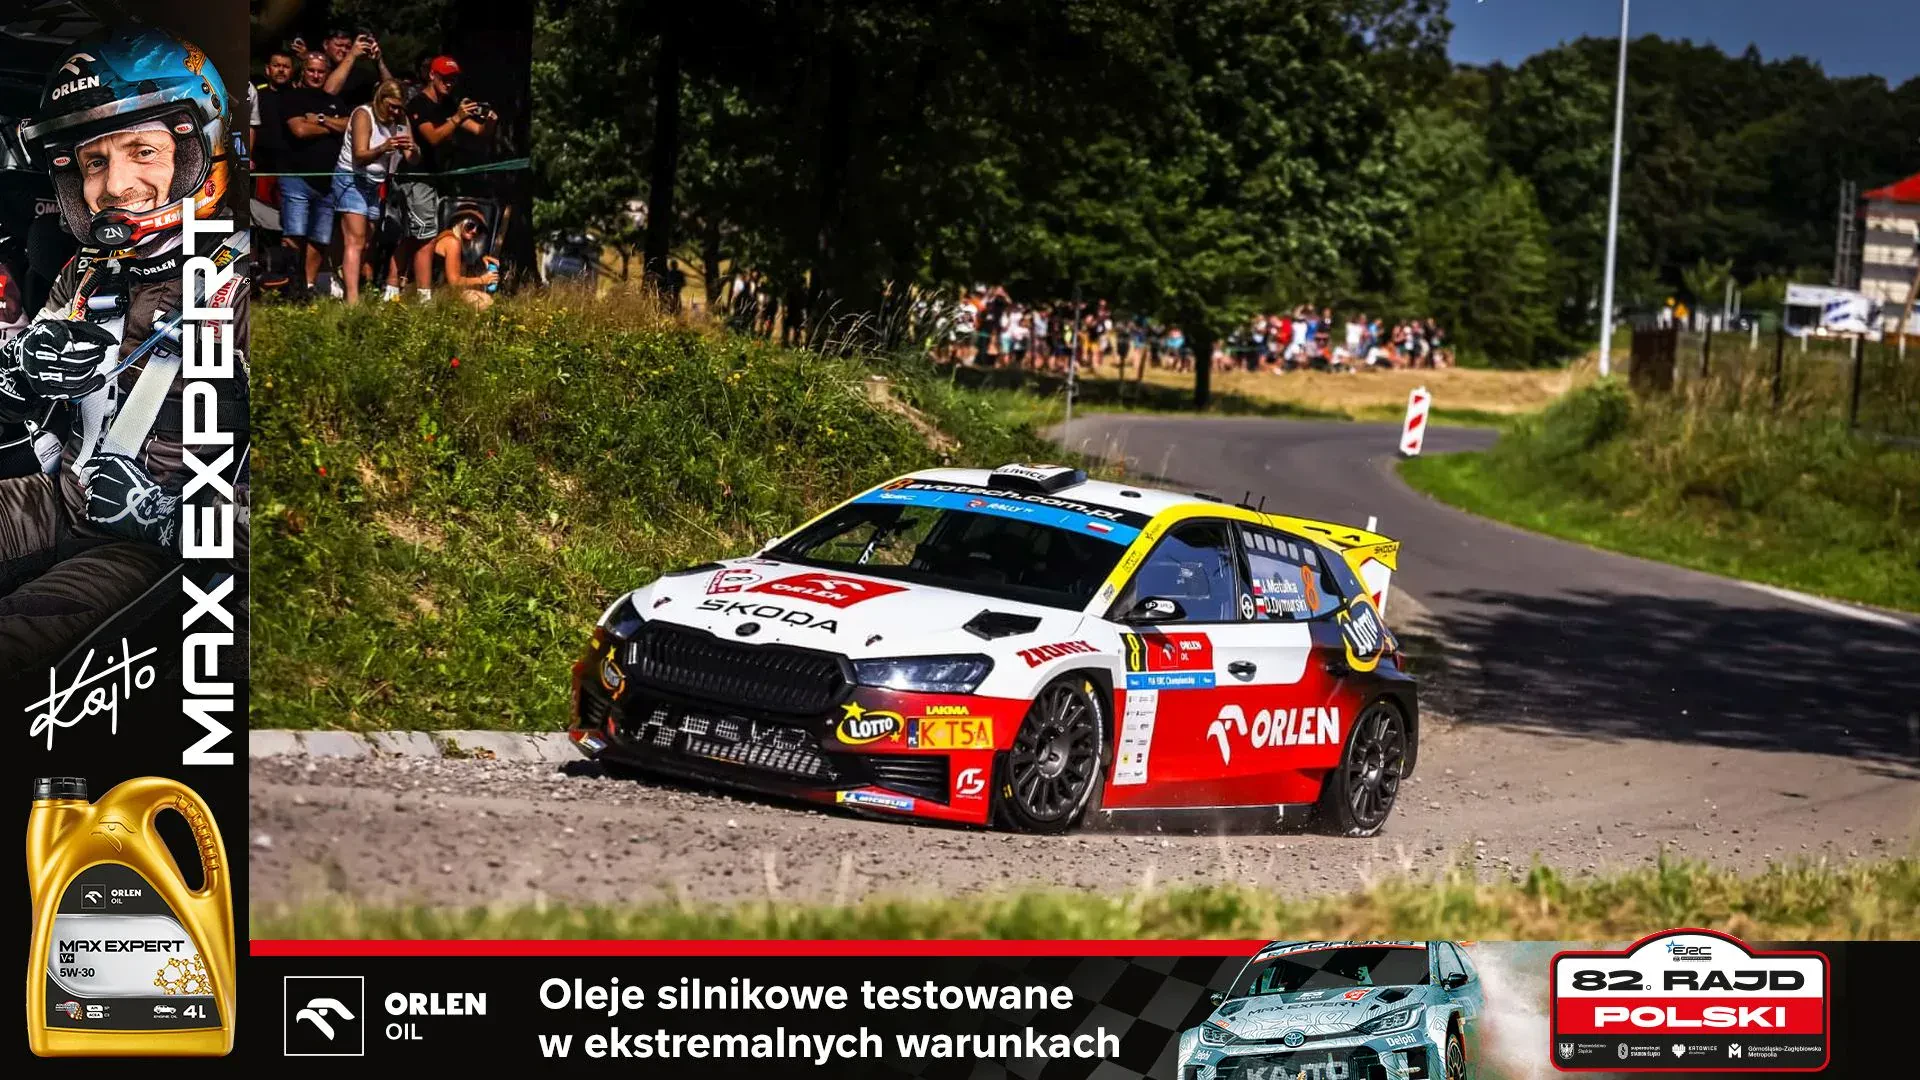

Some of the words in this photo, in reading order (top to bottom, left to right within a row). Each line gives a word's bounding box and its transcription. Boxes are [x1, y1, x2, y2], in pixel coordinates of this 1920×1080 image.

[52, 75, 100, 100] ORLEN
[143, 259, 176, 275] ORLEN
[771, 583, 848, 601] ORLEN
[1300, 564, 1319, 611] 8
[1126, 633, 1140, 672] 8
[1179, 640, 1202, 650] ORLEN
[850, 717, 894, 738] LOTTO
[921, 721, 935, 746] K
[1251, 707, 1340, 749] ORLEN
[111, 889, 142, 897] ORLEN
[60, 940, 102, 952] MAX
[104, 940, 185, 952] EXPERT
[60, 954, 74, 963] V+
[59, 967, 96, 978] 5W-30
[1287, 1001, 1361, 1010] EXPERT
[1385, 1032, 1417, 1048] Delphi
